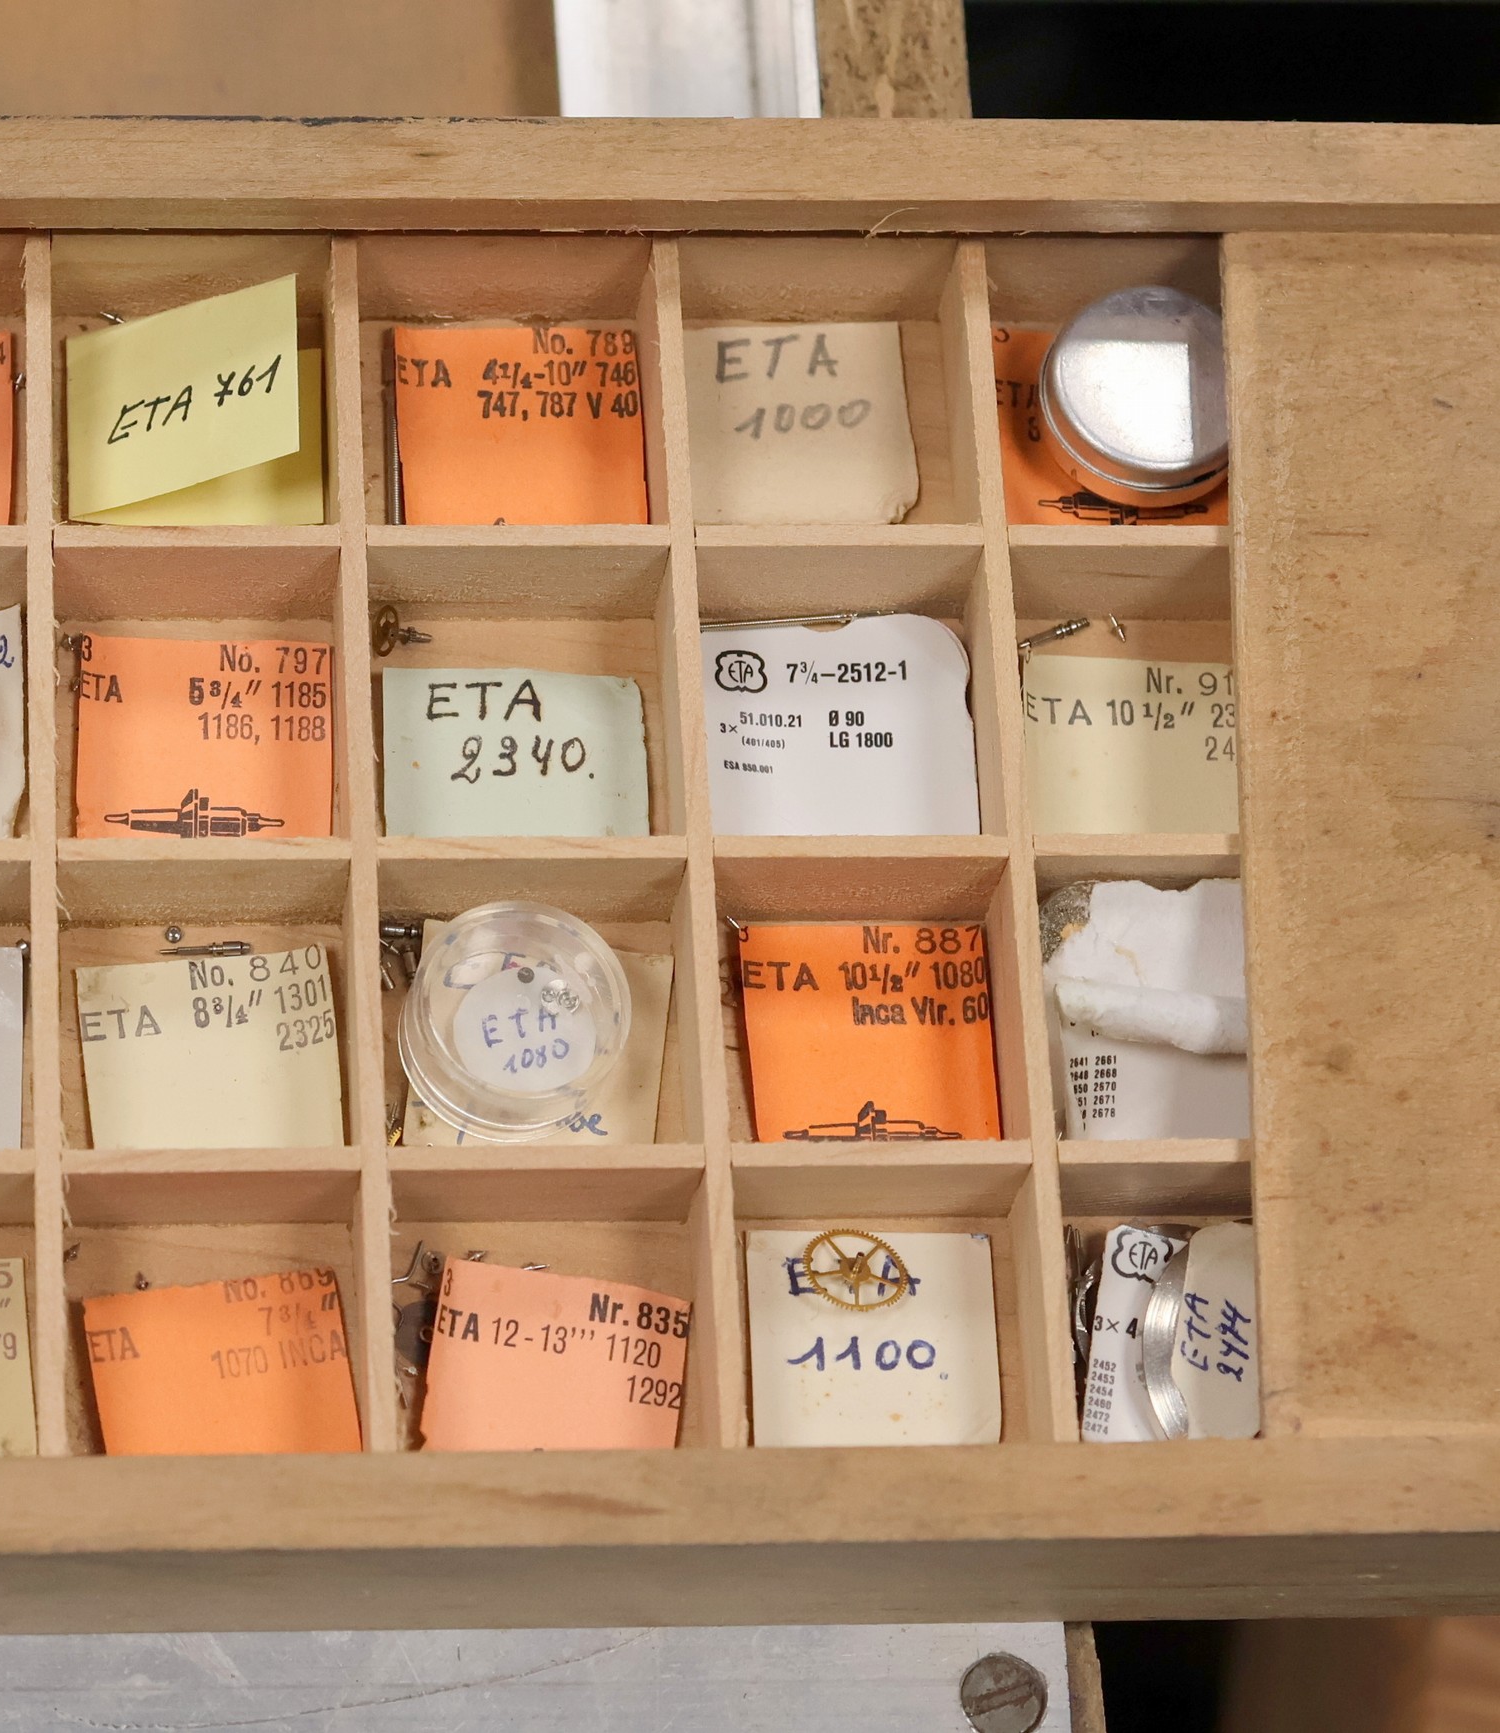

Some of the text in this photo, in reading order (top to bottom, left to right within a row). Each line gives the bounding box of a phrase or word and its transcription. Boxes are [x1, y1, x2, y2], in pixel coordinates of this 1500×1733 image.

[532, 326, 633, 357] No. 789
[715, 333, 838, 383] ETA
[596, 361, 636, 387] 746
[108, 354, 281, 444] ETA 761
[477, 390, 638, 421] 747, 787 V 40
[734, 399, 872, 440] 1000
[220, 644, 327, 675] No. 797
[728, 660, 754, 683] ETA
[80, 670, 326, 709] ETA 1185
[1146, 667, 1182, 695] Nr.
[426, 679, 541, 721] ETA
[1027, 691, 1092, 726] ETA
[198, 712, 326, 745] 1186, 1188
[739, 711, 864, 728] 51.010.21 90
[741, 735, 785, 749] (401/405)
[829, 732, 893, 748] LG 1800
[723, 760, 740, 771] ESA
[862, 924, 981, 955] Nr. 887
[189, 943, 322, 990] No. 840
[743, 957, 986, 992] ETA 1080
[81, 974, 328, 1042] ETA 1301
[851, 992, 989, 1025] Inca 60
[276, 1009, 335, 1051] 2325
[481, 1007, 557, 1048] ETA
[502, 1038, 570, 1074] 1080
[1070, 1055, 1117, 1068] 2641 2661
[1094, 1068, 1117, 1079] 2668
[1094, 1082, 1116, 1092] 2670
[1092, 1108, 1115, 1118] 2678
[1093, 1095, 1115, 1105] 2671
[1129, 1241, 1158, 1270] ETA
[444, 1268, 453, 1297] 3
[589, 1292, 690, 1339] Nr. 835
[437, 1304, 661, 1368] ETA 1120
[1180, 1292, 1211, 1371] ETA
[86, 1326, 347, 1379] ETA 1070 INCA
[1093, 1358, 1116, 1372] 2452
[627, 1375, 682, 1410] 1292
[1089, 1384, 1113, 1398] 2454
[1091, 1371, 1115, 1385] 2453
[1084, 1421, 1108, 1435] 2474
[1086, 1409, 1110, 1422] 2472
